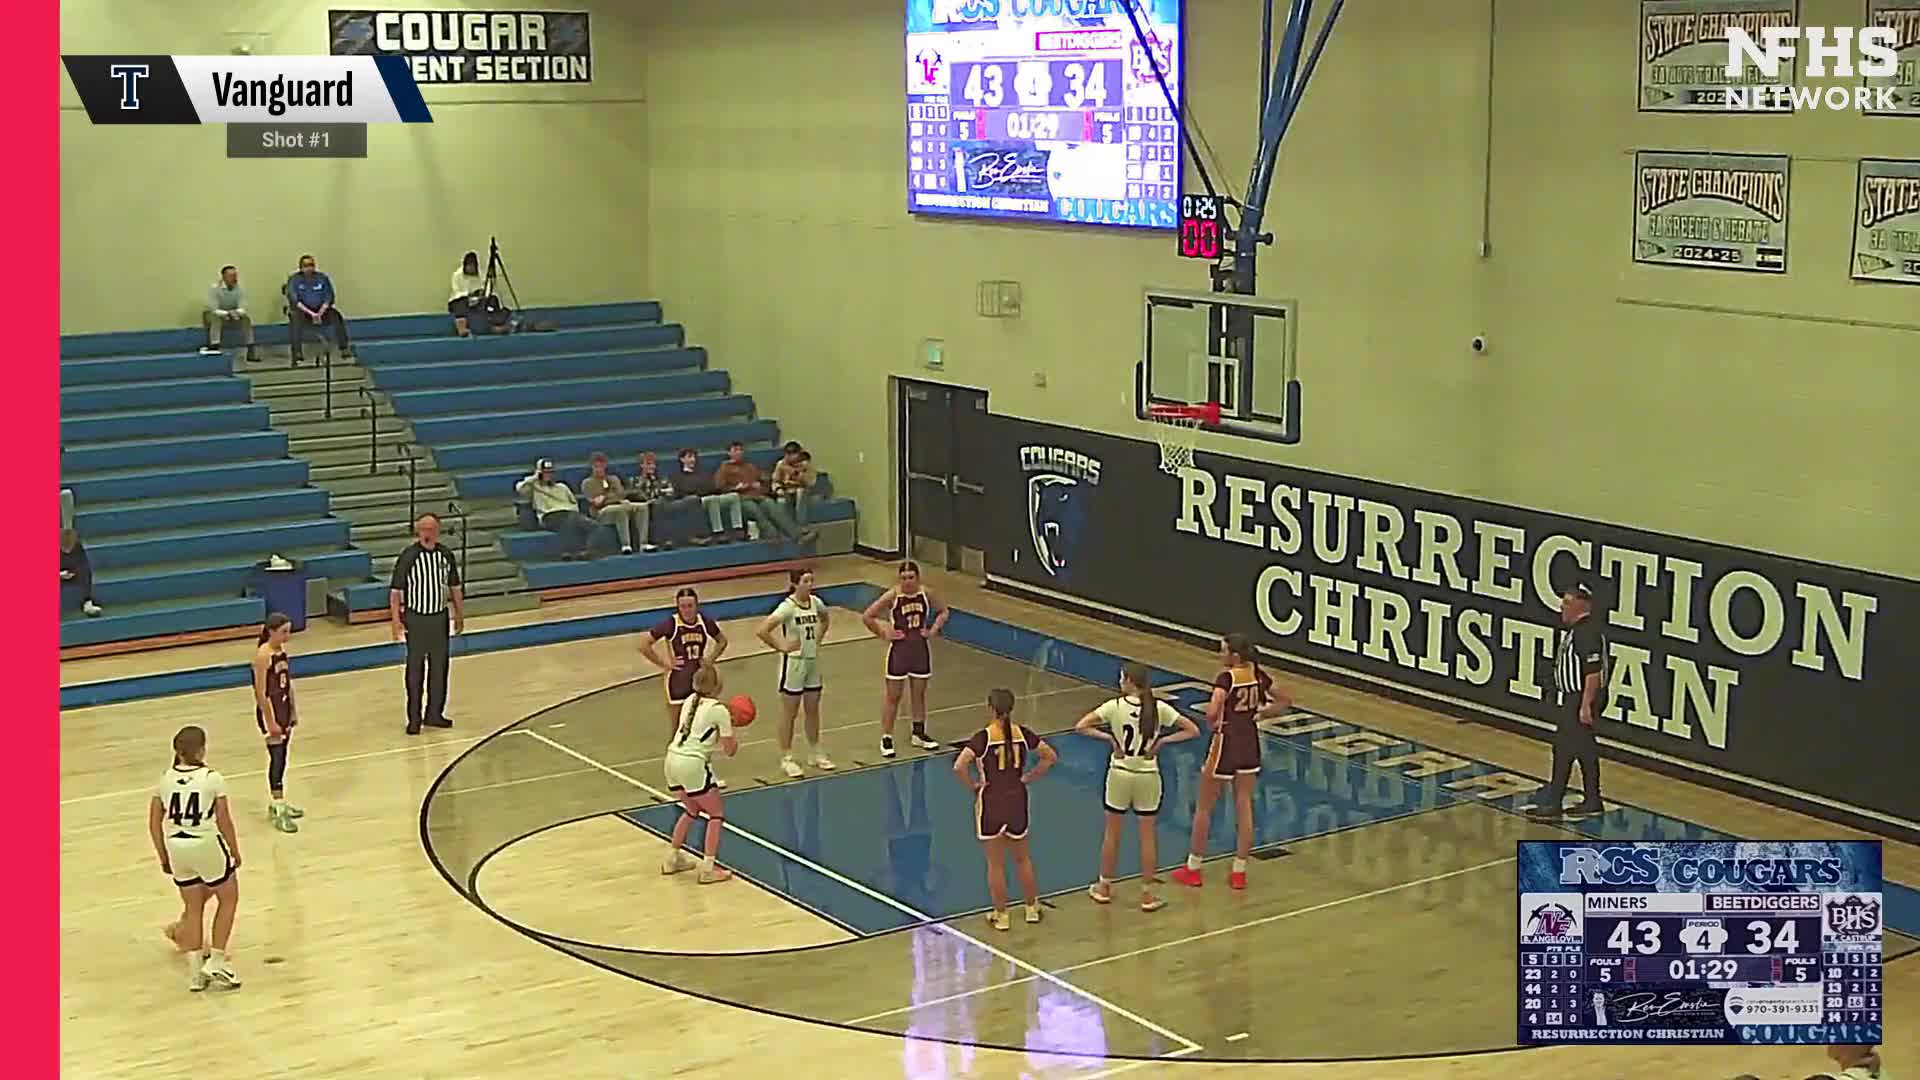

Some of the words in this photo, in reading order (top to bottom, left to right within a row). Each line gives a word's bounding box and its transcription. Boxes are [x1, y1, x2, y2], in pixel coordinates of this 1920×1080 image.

[376, 12, 546, 51] COUGAR
[1646, 13, 1695, 61] STATE
[476, 57, 587, 81] SECTION
[964, 63, 1004, 108] 43
[1063, 62, 1108, 109] 34
[1641, 167, 1689, 214] STATE
[1691, 169, 1784, 222] CHAMPIONS
[1183, 220, 1217, 257] 00
[1674, 246, 1742, 263] 2024-25
[1020, 446, 1101, 485] COUGARS
[1176, 467, 1878, 681] RESURRECTION
[1256, 565, 1739, 750] CHRISTAN
[167, 791, 202, 827] 44
